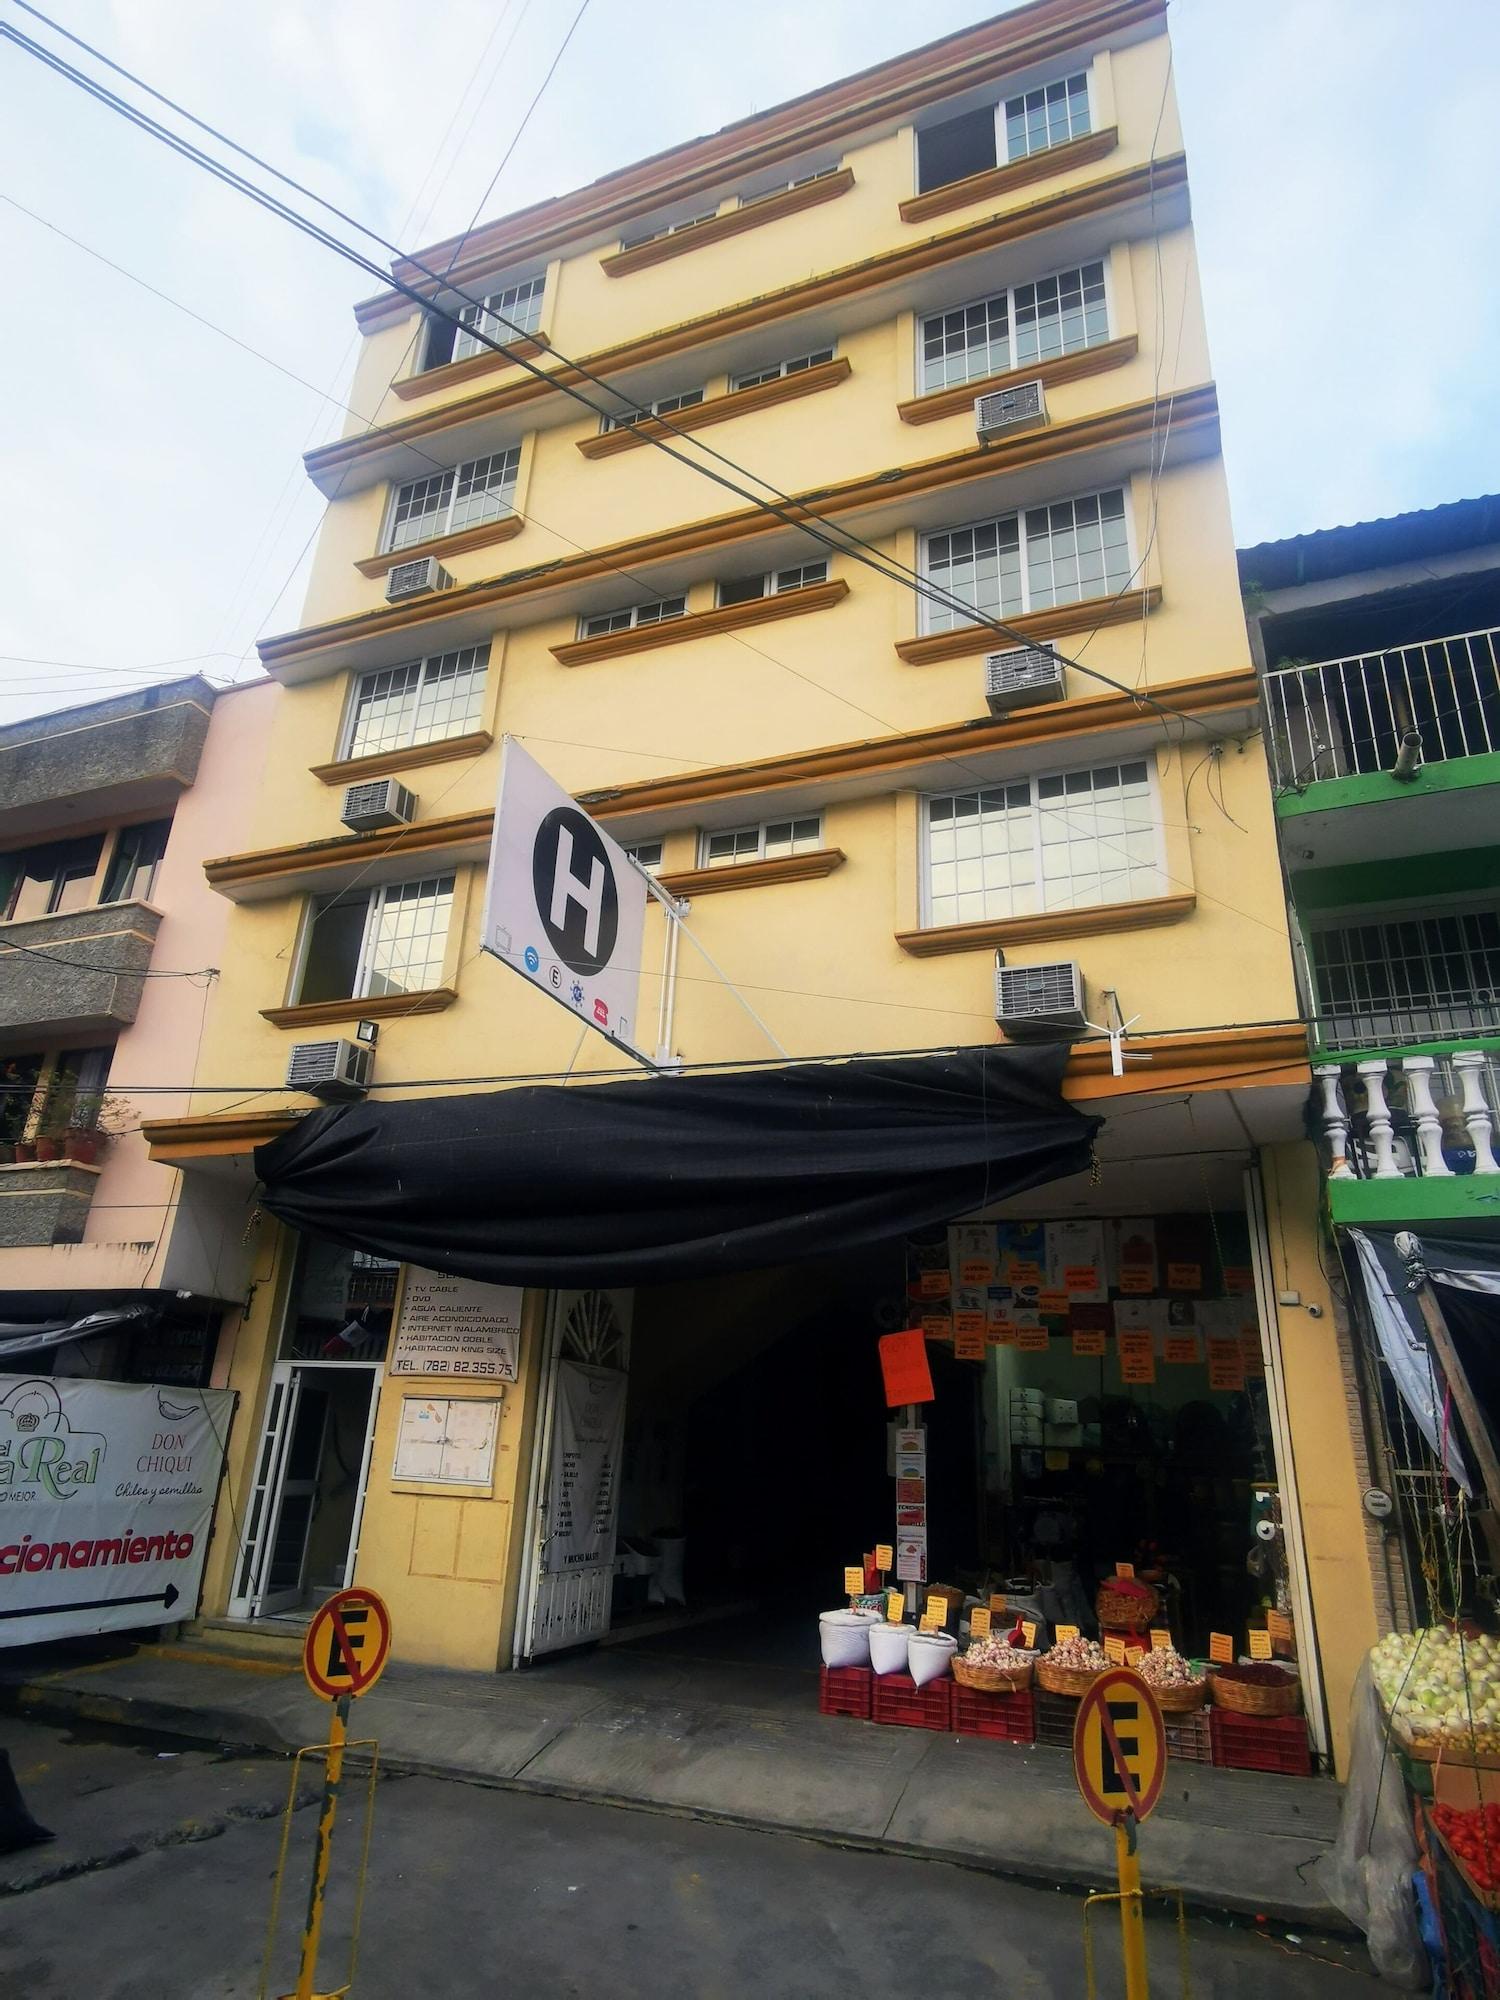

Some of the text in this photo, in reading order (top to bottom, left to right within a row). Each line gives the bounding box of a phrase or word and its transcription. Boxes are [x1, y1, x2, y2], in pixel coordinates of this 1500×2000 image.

[550, 824, 605, 958] H
[439, 1305, 484, 1313] CALIENTE
[432, 1315, 509, 1323] ACONDICIONADO
[454, 1325, 520, 1335] INALAMBRICO
[406, 1335, 494, 1344] HABITACION DOBLE
[404, 1344, 508, 1355] HABITACION KING SIZE
[396, 1360, 419, 1371] TEL.
[152, 1433, 188, 1450] DON
[18, 1436, 101, 1500] Real
[136, 1455, 194, 1474] CHIQUI
[115, 1482, 204, 1505] Chiles y semillas
[0, 1528, 194, 1575] cionamiento
[327, 1610, 368, 1677] E
[1100, 1702, 1141, 1793] E
